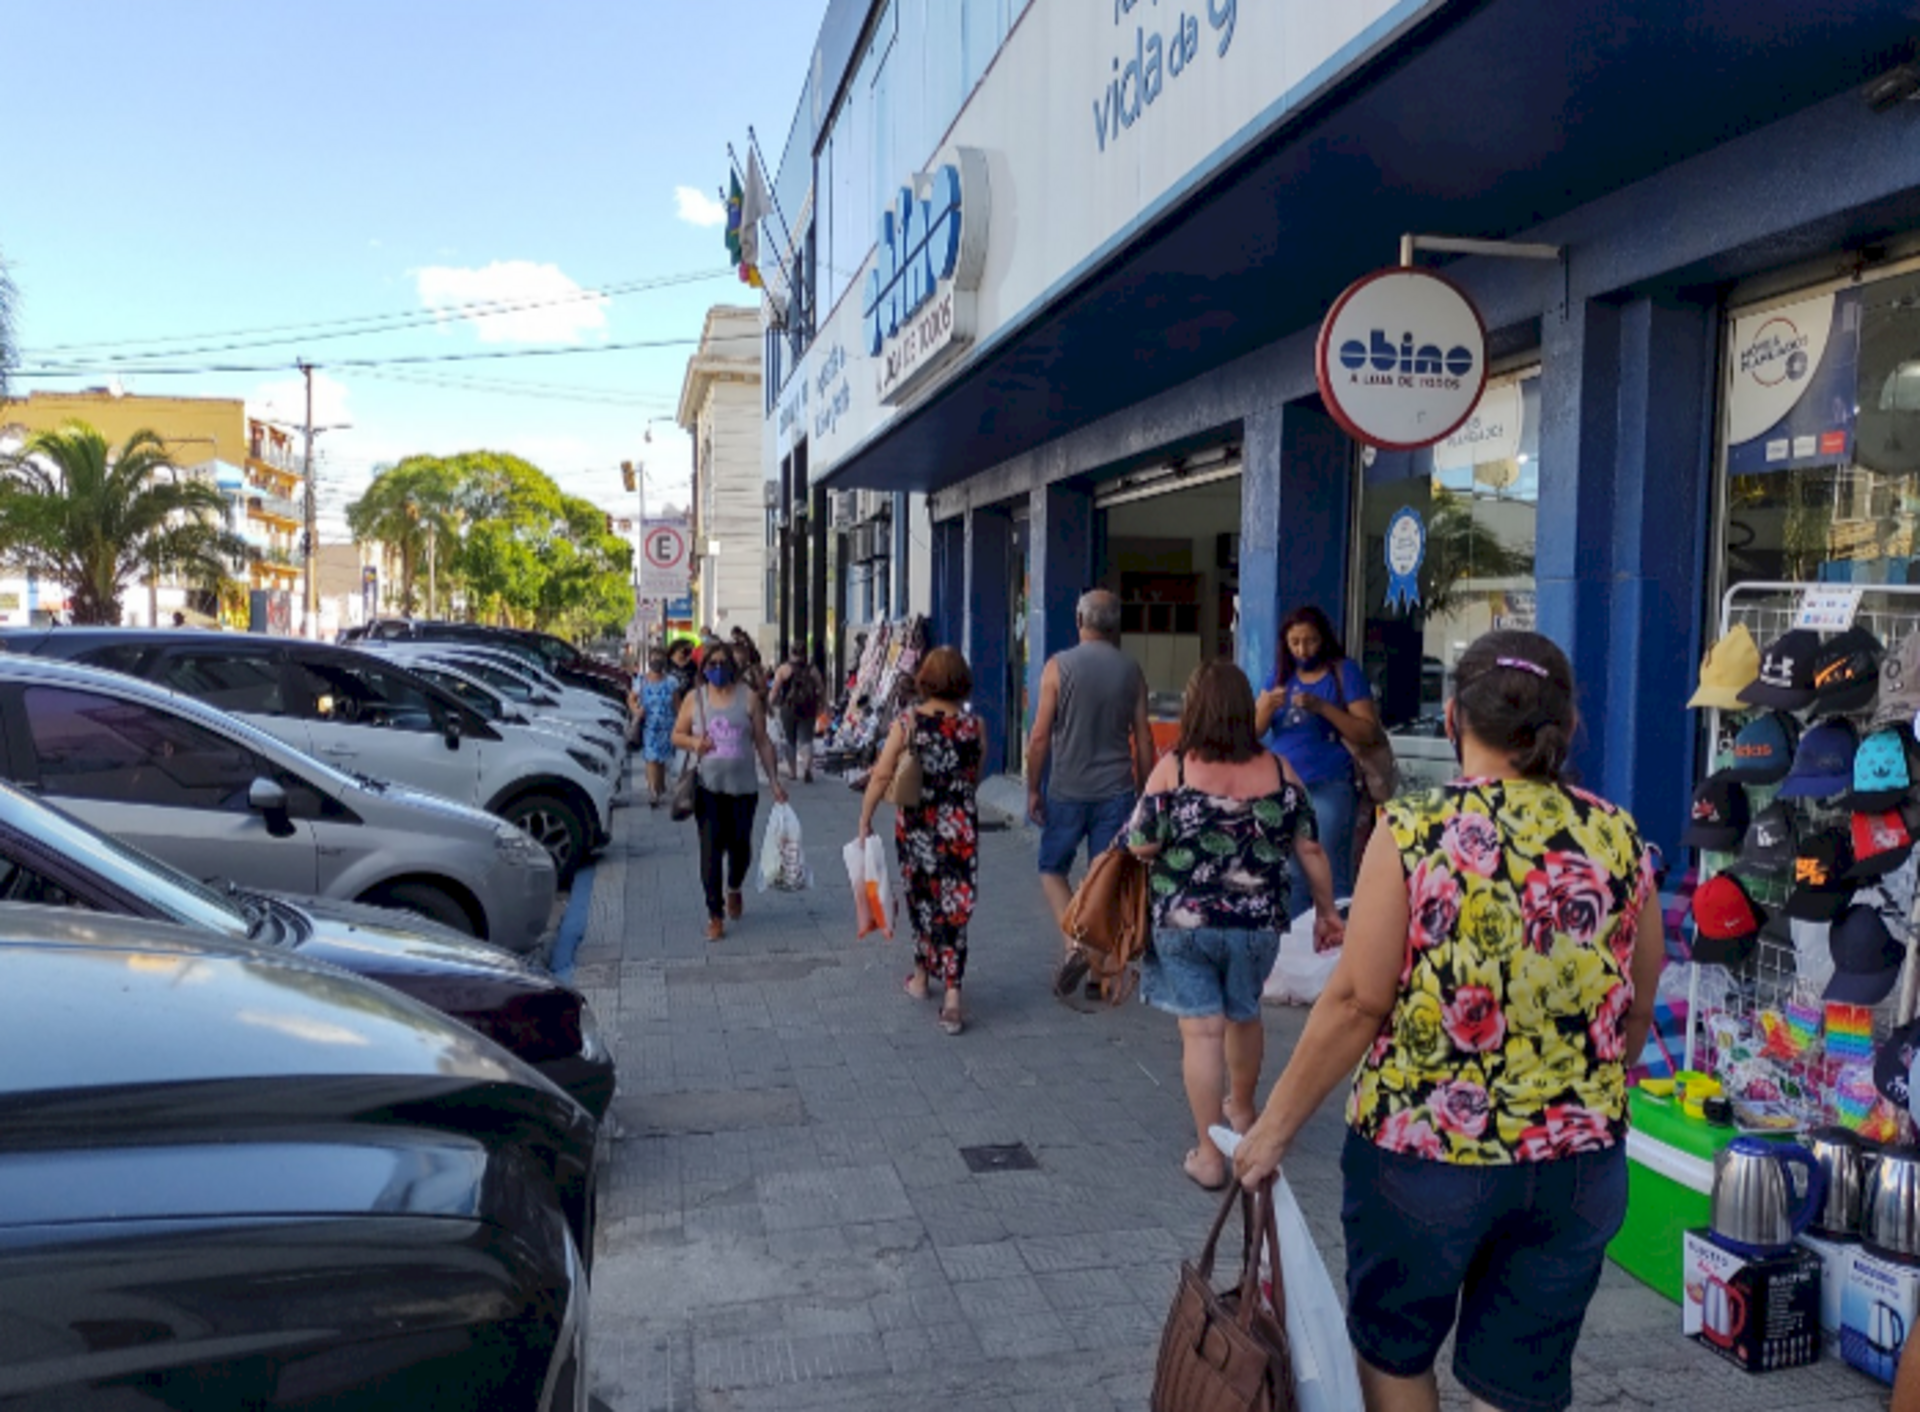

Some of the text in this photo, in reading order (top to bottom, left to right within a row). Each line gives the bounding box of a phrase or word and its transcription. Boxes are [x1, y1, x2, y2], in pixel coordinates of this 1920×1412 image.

[1093, 26, 1162, 152] vida
[1168, 11, 1198, 78] da
[1339, 328, 1473, 377] obino
[1399, 376, 1414, 387] DE
[656, 535, 671, 560] E
